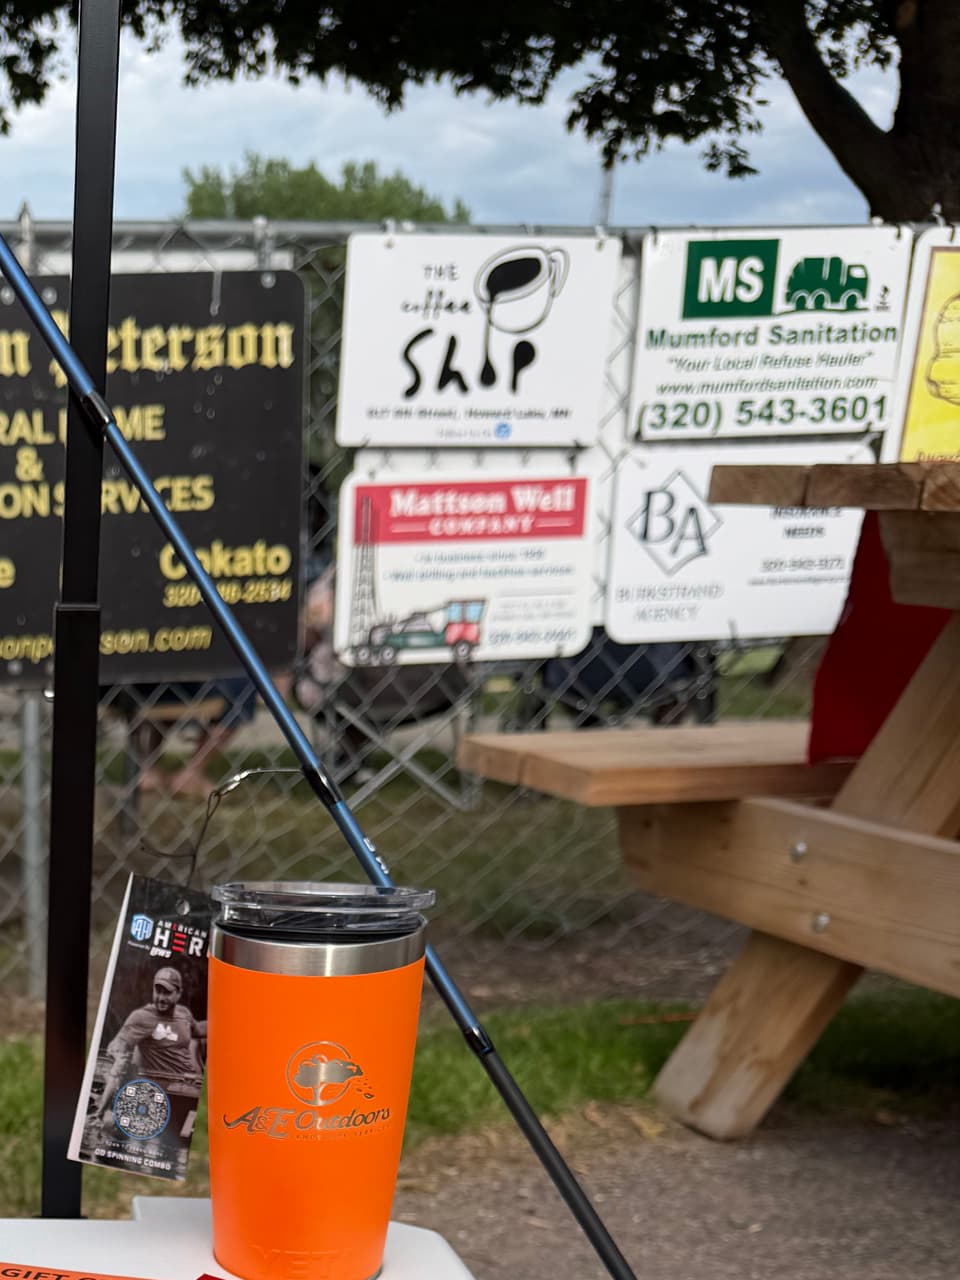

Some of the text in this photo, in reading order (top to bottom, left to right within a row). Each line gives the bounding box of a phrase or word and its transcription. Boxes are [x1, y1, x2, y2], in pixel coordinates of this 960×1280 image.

[422, 264, 460, 281] THE
[696, 255, 765, 304] MS
[400, 289, 473, 320] coffee
[645, 322, 898, 350] Mumford Sanitation
[638, 395, 887, 434] (320) 543-3601
[15, 446, 45, 482] &
[53, 474, 216, 518] SRVCES
[389, 485, 576, 518] Mattson Well
[428, 514, 535, 537] COMPANY
[153, 927, 210, 958] HER
[157, 920, 208, 939] AMERICAN
[223, 1106, 296, 1140] A&E
[295, 1106, 391, 1131] Outdoors
